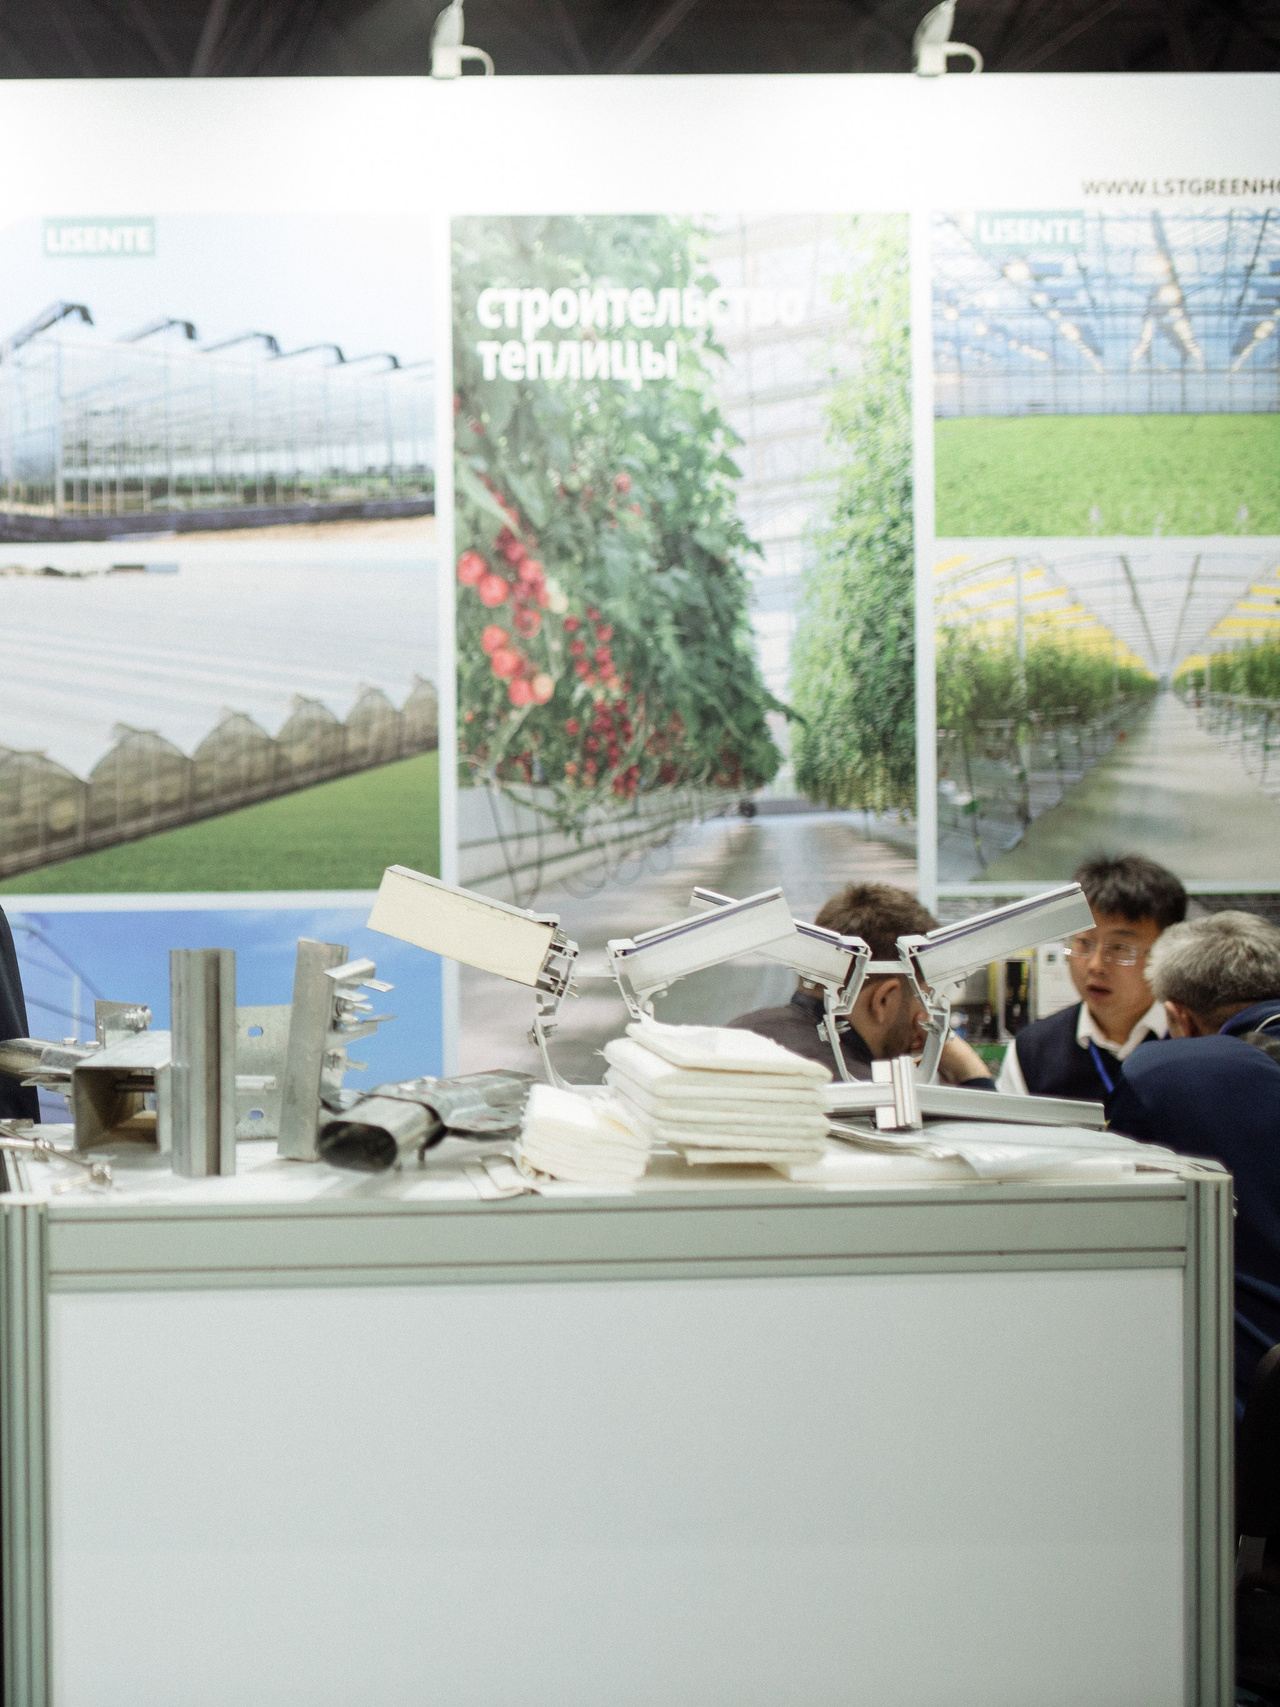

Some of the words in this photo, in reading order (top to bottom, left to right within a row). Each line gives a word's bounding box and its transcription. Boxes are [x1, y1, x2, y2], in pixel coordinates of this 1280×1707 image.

[1082, 178, 1280, 196] WWW.LSTGREENH
[46, 226, 151, 251] LISENTE
[476, 287, 808, 342] строительство
[476, 339, 679, 392] теплицы
